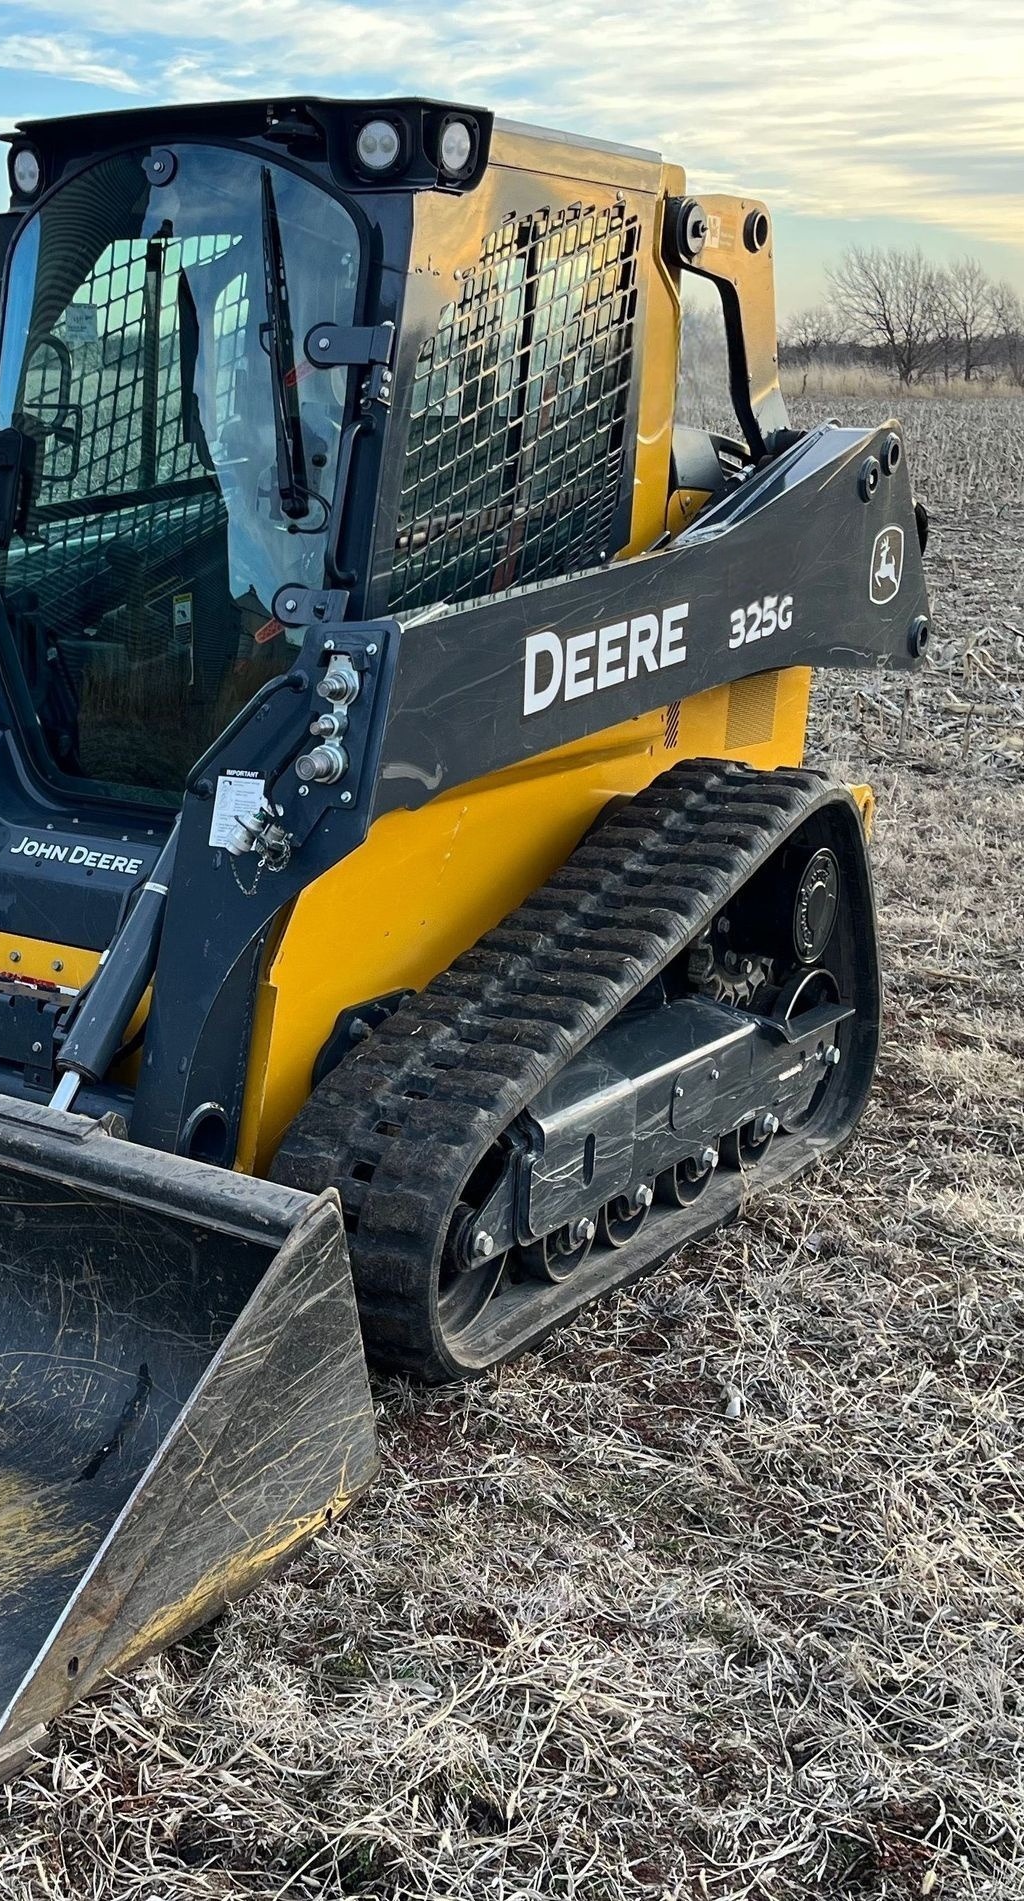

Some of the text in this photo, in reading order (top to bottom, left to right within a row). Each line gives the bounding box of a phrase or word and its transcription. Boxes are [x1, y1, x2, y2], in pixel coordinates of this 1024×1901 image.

[728, 594, 794, 649] 325G
[523, 602, 689, 716] DEERE
[226, 769, 259, 778] IMPORTANT
[10, 836, 143, 875] JOHN DEERE
